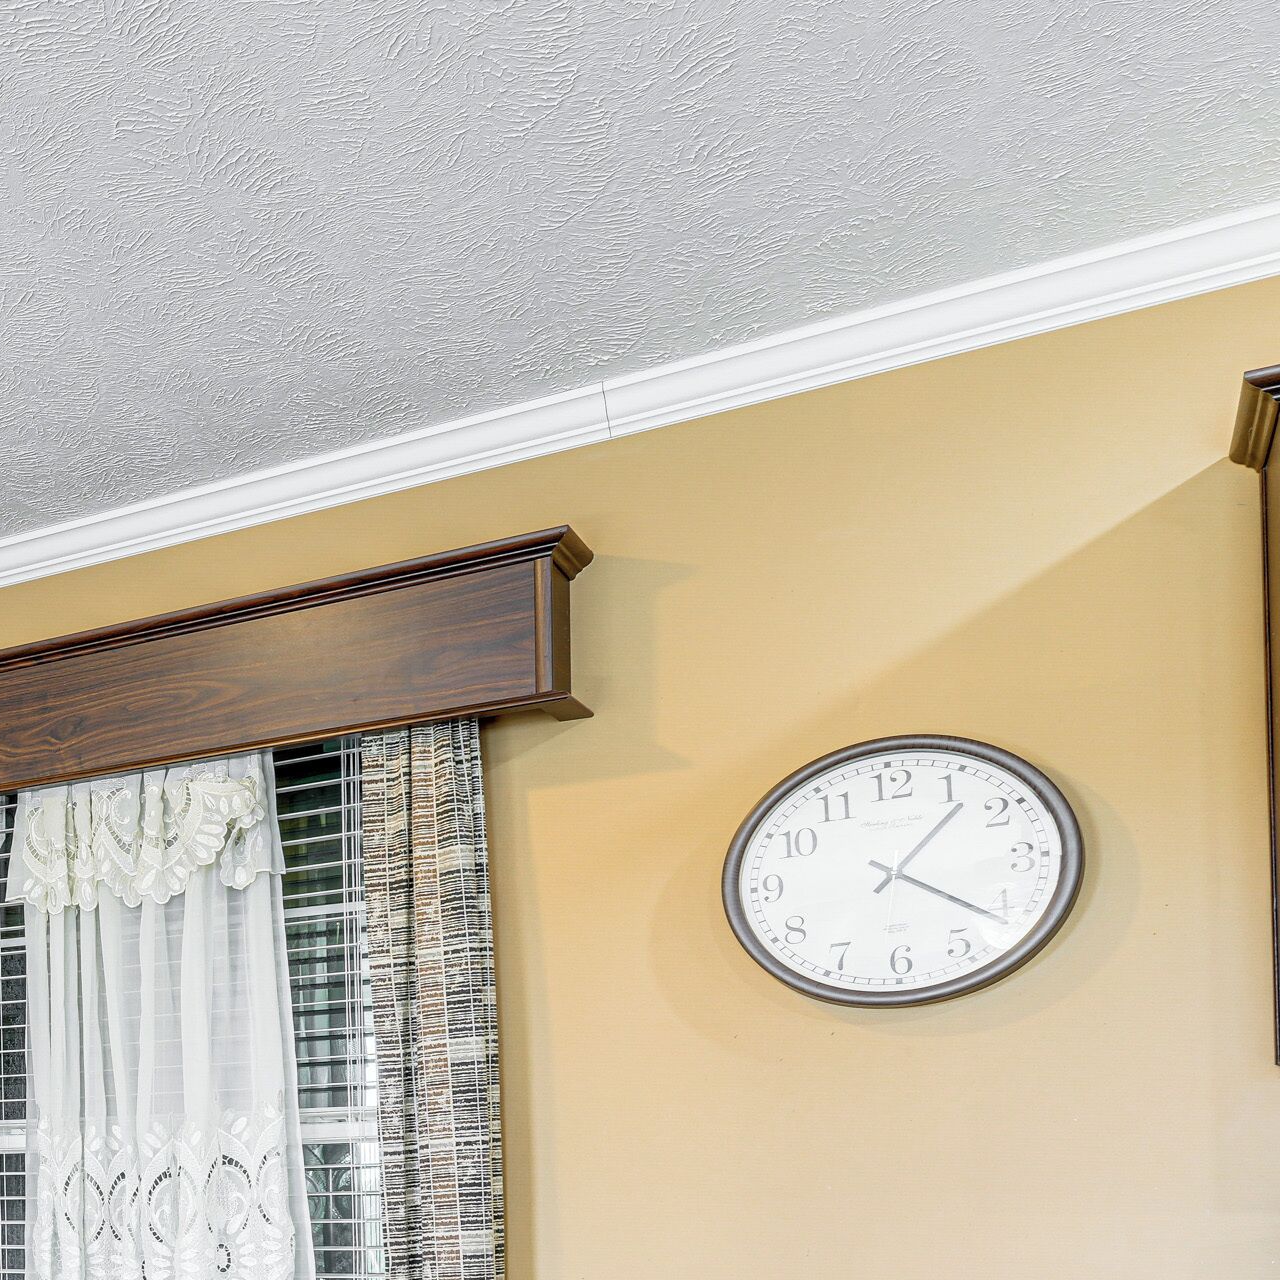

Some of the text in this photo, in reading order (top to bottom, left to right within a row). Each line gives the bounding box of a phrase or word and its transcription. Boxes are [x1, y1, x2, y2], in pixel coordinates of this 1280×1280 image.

[871, 769, 913, 803] 12
[937, 773, 963, 804] 1
[816, 791, 857, 824] 11
[984, 797, 1011, 828] 2
[779, 827, 818, 860] 10
[1010, 841, 1036, 872] 3
[762, 874, 784, 903] 9
[987, 888, 1015, 919] 4
[784, 915, 807, 945] 8
[947, 928, 971, 958] 5
[830, 941, 852, 971] 7
[889, 944, 914, 975] 6
